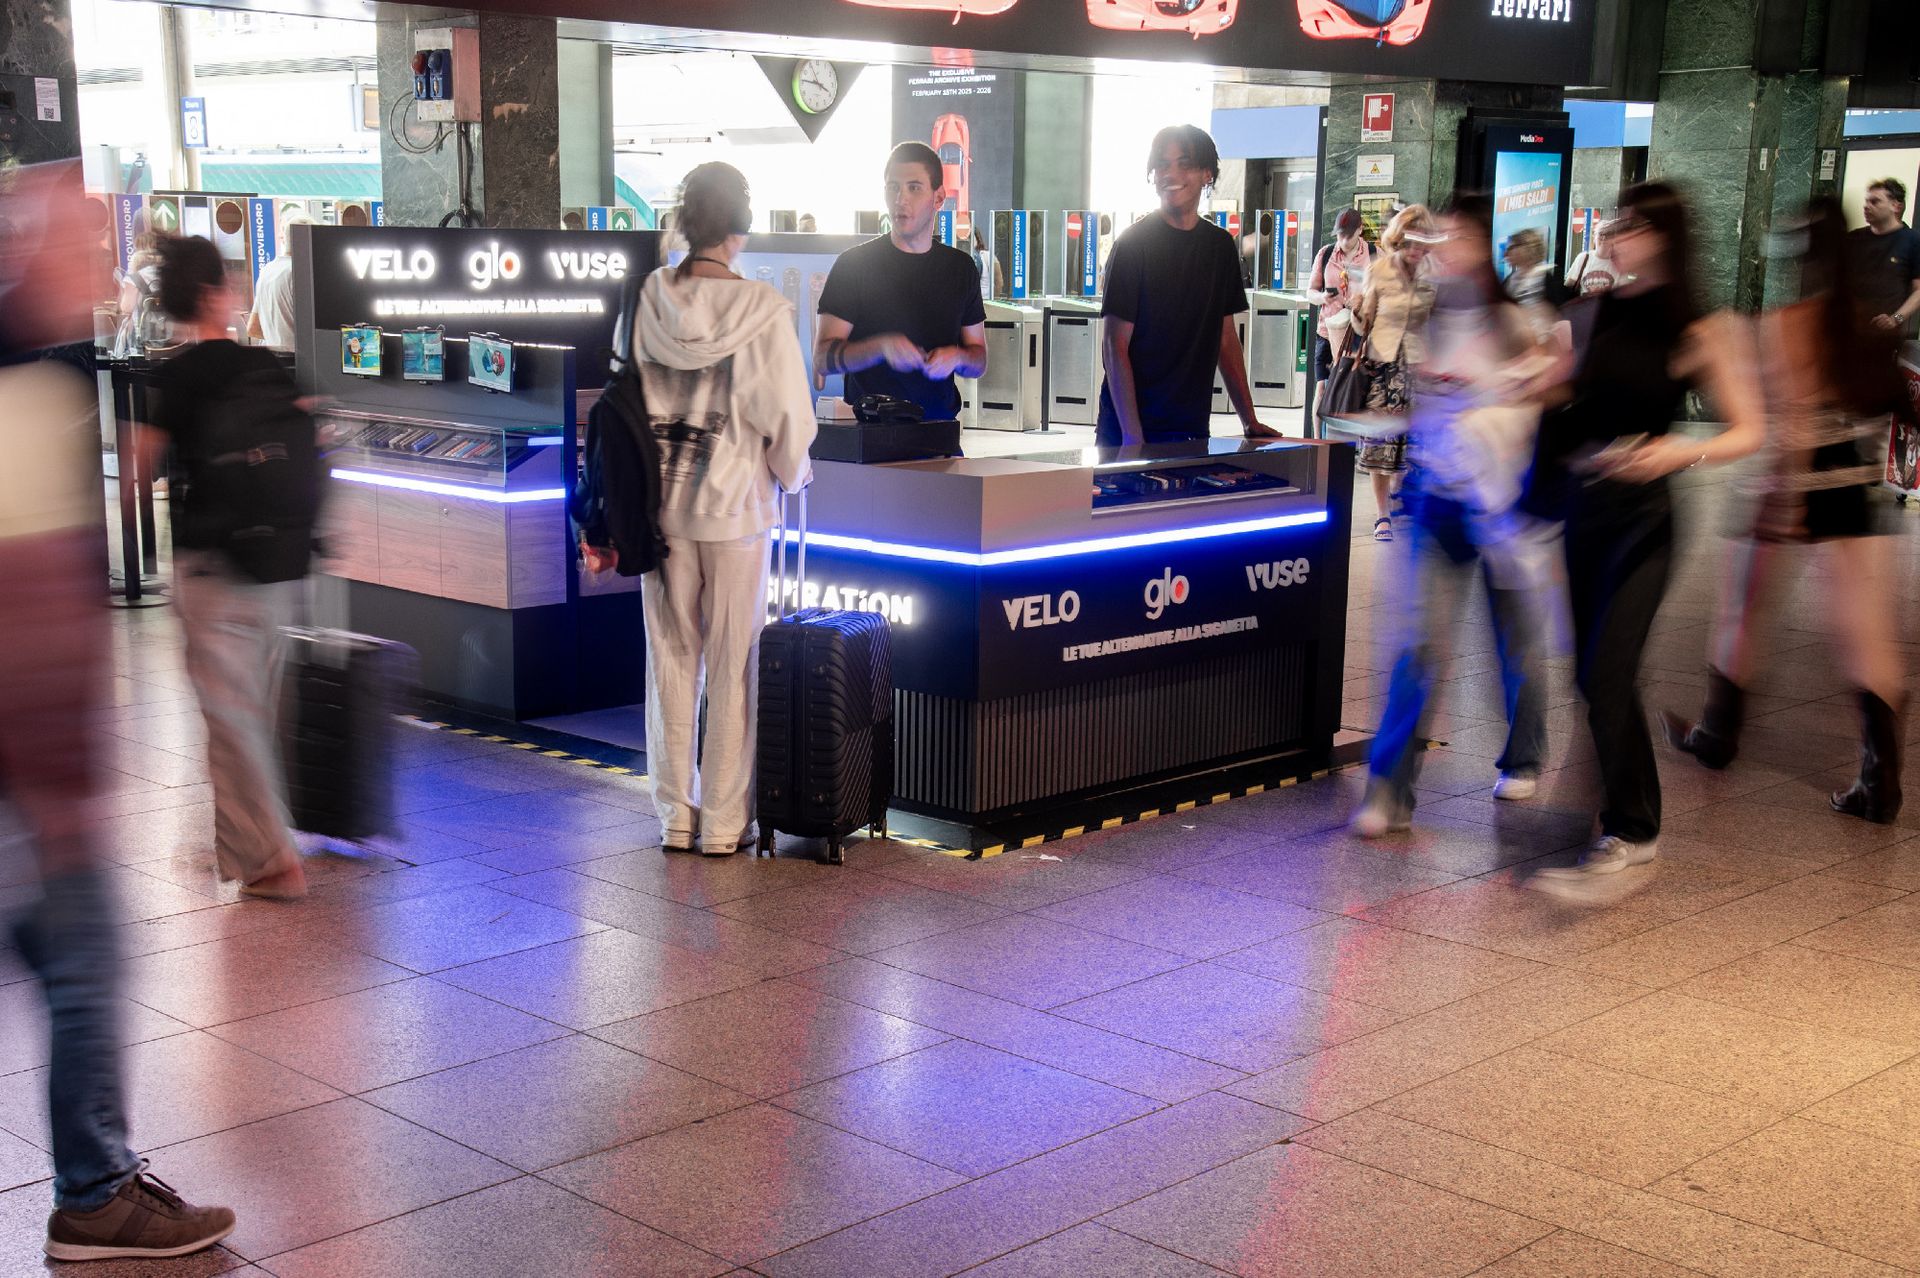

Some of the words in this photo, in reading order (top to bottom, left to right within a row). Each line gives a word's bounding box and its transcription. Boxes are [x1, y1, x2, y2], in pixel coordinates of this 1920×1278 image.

[942, 68, 975, 76] EXCLUSIVE
[961, 74, 996, 82] EXHIBITION
[1526, 188, 1549, 207] SALDI
[347, 249, 435, 280] VELO
[470, 241, 521, 290] glo
[1002, 590, 1080, 631] VELO
[1144, 566, 1190, 620] glo
[1062, 646, 1078, 662] LE
[1078, 642, 1102, 660] TUE
[1174, 625, 1202, 643] ALLA
[1201, 615, 1259, 638] SIGARETTA
